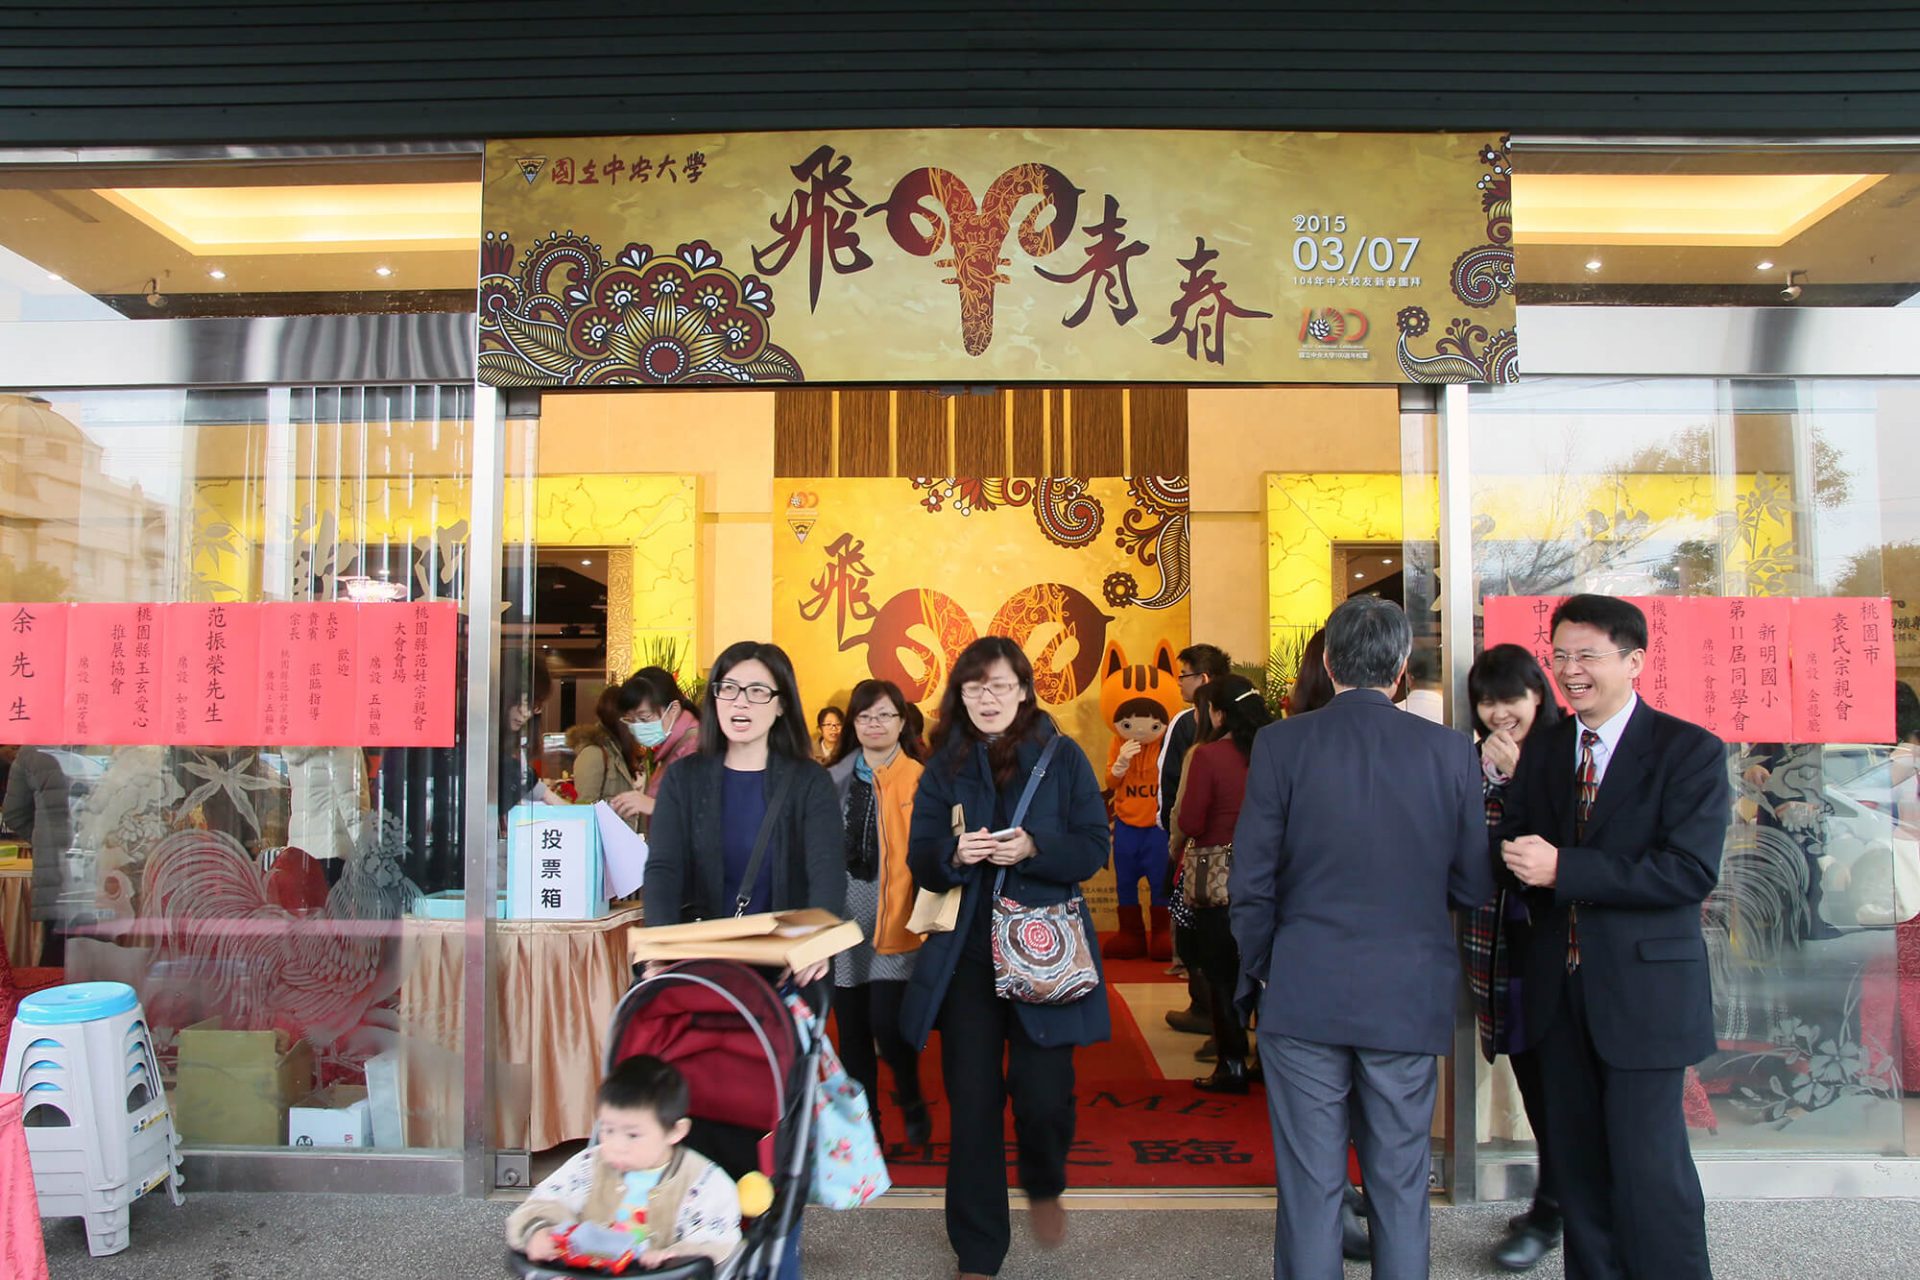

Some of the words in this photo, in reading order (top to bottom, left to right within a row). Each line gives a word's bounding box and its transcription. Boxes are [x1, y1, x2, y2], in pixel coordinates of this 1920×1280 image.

[552, 151, 707, 185] 國立中央大學
[1292, 214, 1347, 233] 2015
[1292, 236, 1421, 275] 03/07
[110, 624, 126, 695] 推展協會
[326, 611, 339, 640] 長官
[393, 622, 407, 684] 大會會場
[1859, 601, 1881, 666] 桃園市
[9, 607, 36, 721] 余先生
[205, 607, 227, 723] 范振榮先生
[413, 605, 430, 732] 桃園縣范姓宗親會
[1729, 600, 1750, 732] 第11屆同學會
[1758, 622, 1779, 709] 新明國小
[1831, 612, 1853, 721] 袁氏宗親會
[1126, 784, 1159, 798] NCU
[541, 828, 562, 909] 投票箱
